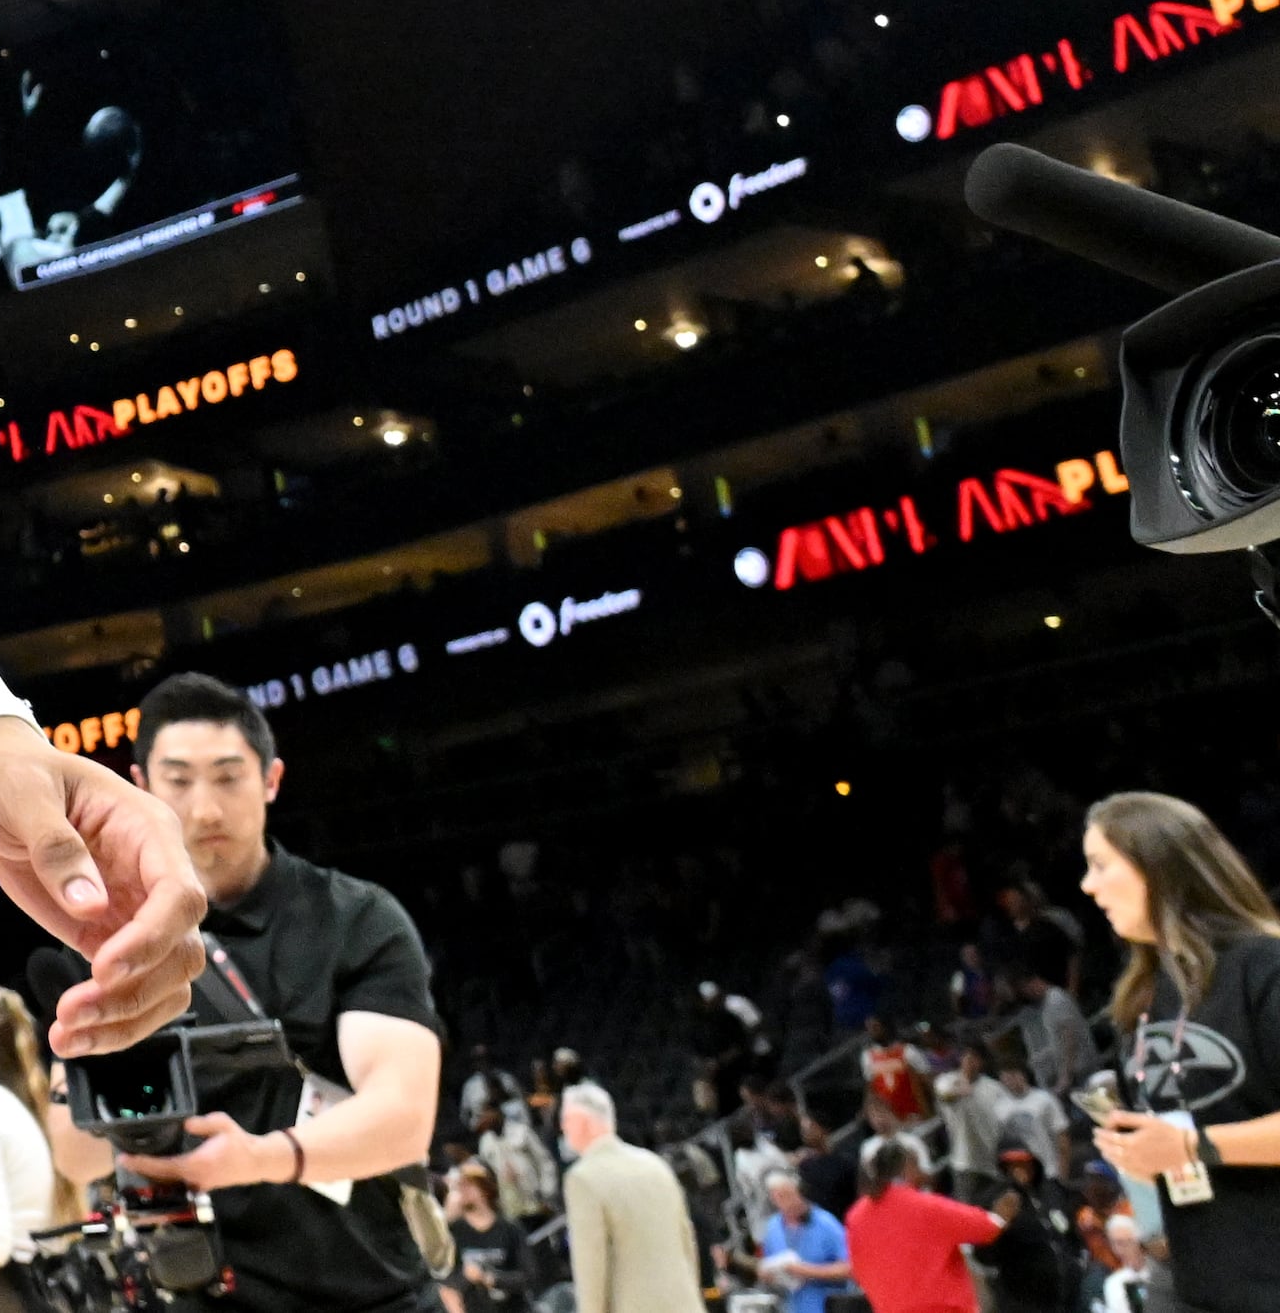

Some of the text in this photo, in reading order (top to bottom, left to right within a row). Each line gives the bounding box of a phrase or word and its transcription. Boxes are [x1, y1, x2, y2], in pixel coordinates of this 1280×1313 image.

[372, 286, 461, 341] ROUND
[465, 279, 481, 305] 1
[486, 244, 567, 297] GAME
[112, 347, 300, 431] PLAYOFFS
[290, 672, 306, 703] 1
[311, 648, 393, 696] GAME
